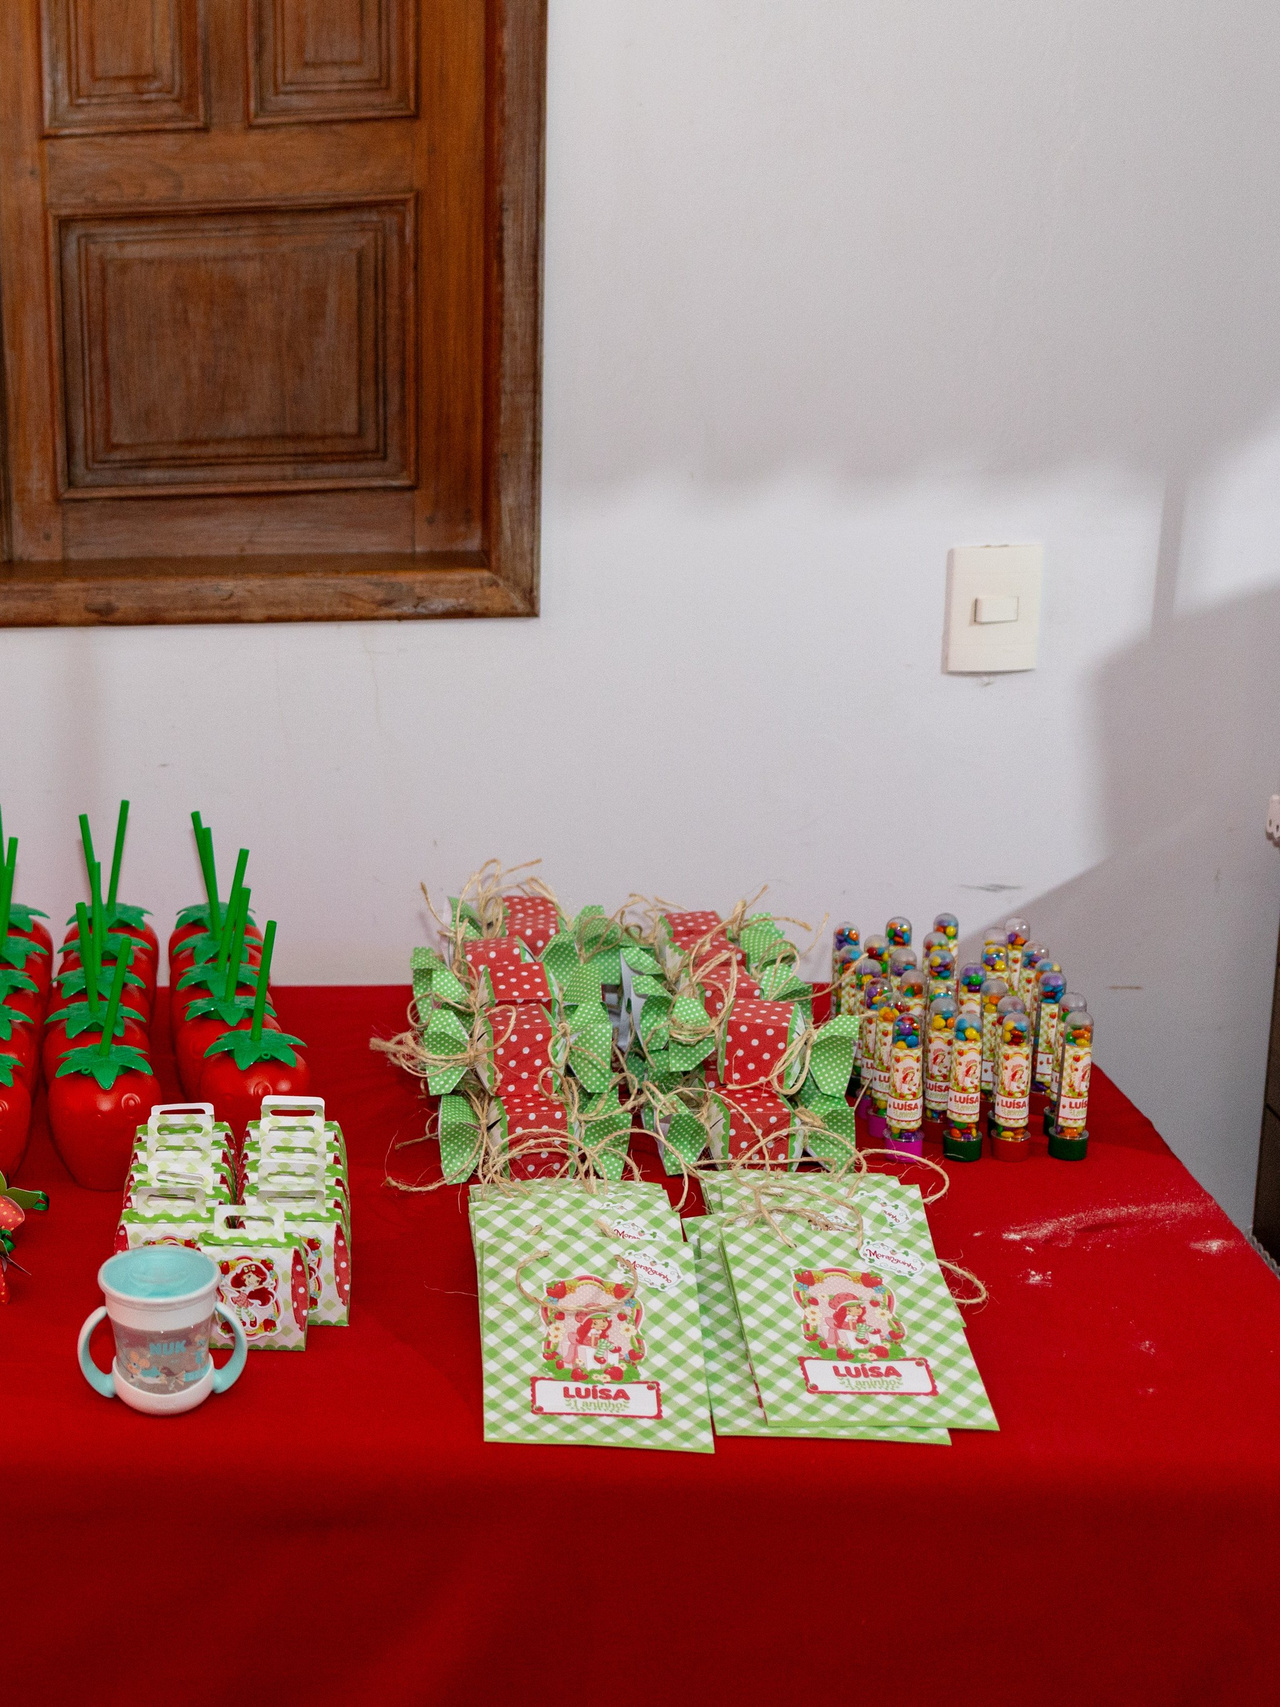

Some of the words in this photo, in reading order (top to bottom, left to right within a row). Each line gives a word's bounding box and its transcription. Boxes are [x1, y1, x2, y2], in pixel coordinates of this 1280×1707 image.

[893, 1101, 918, 1111] LUÍSA
[954, 1095, 979, 1105] LUÍSA
[1001, 1099, 1026, 1109] LUÍSA
[866, 1248, 917, 1271] Moranguinho
[149, 1340, 187, 1356] NUK
[832, 1363, 902, 1378] LUÍSA
[563, 1385, 630, 1400] LUÍSA
